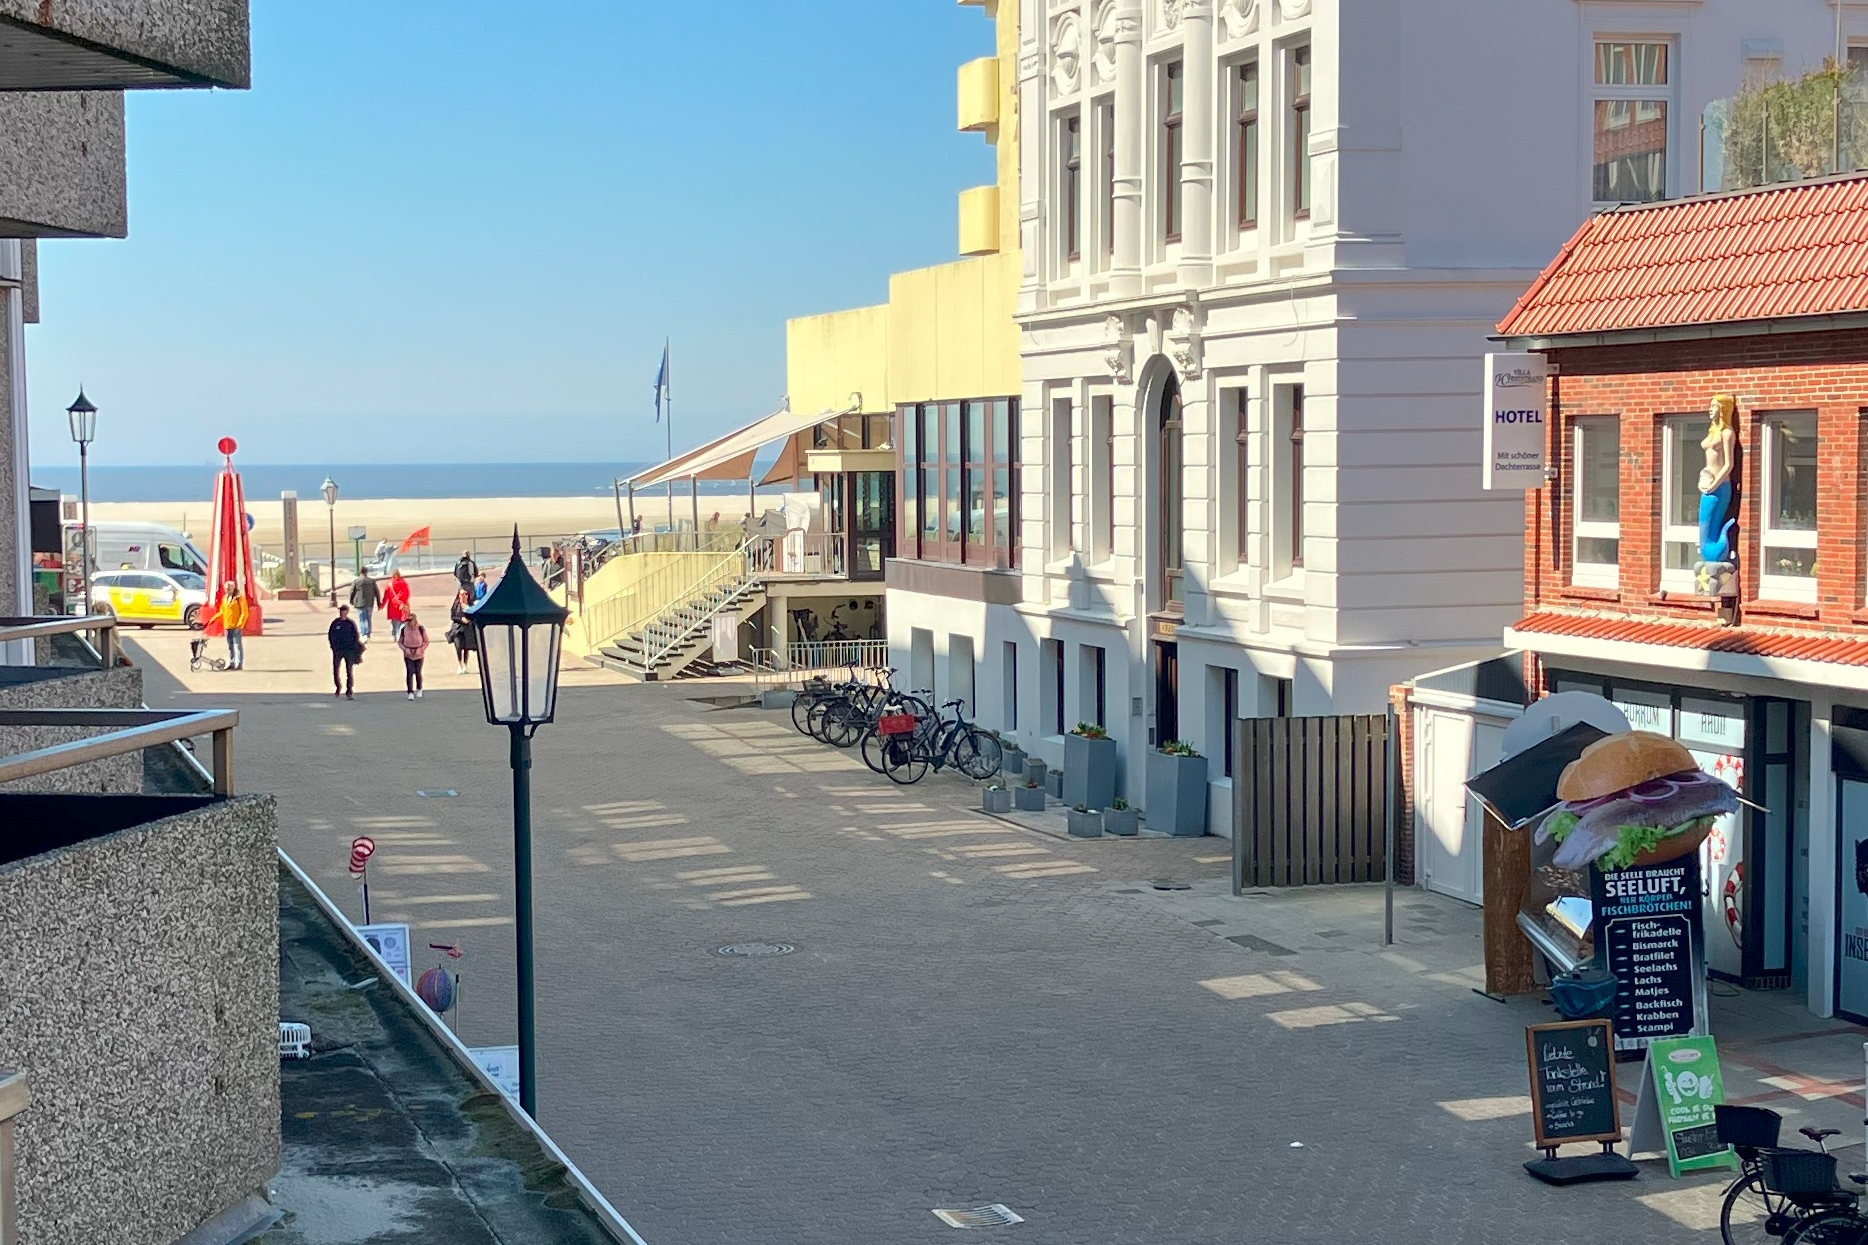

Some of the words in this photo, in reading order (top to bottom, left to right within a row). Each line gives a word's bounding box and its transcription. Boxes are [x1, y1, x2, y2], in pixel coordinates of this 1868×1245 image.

[1495, 410, 1543, 423] HOTEL
[1497, 452, 1510, 460] Mit
[1511, 452, 1539, 460] schöner
[1495, 463, 1541, 471] Dachterrasse
[1604, 873, 1619, 881] DIE
[1620, 871, 1643, 880] SEELE
[1645, 867, 1685, 878] BRAUCHT
[1605, 876, 1686, 898] SEELUFT,
[1601, 900, 1693, 917] FISCHBRÖTCHEN!
[1632, 921, 1661, 931] Fisch-
[1632, 927, 1682, 939] frikadelle
[1632, 939, 1679, 951] Bismarck
[1632, 951, 1675, 962] Bratfilet
[1634, 962, 1678, 973] Seelachs
[1634, 975, 1662, 985] Lachs
[1634, 986, 1669, 997] Matjes
[1635, 999, 1683, 1010] Backfisch
[1636, 1011, 1679, 1021] Krabben
[1637, 1022, 1674, 1033] Scampi
